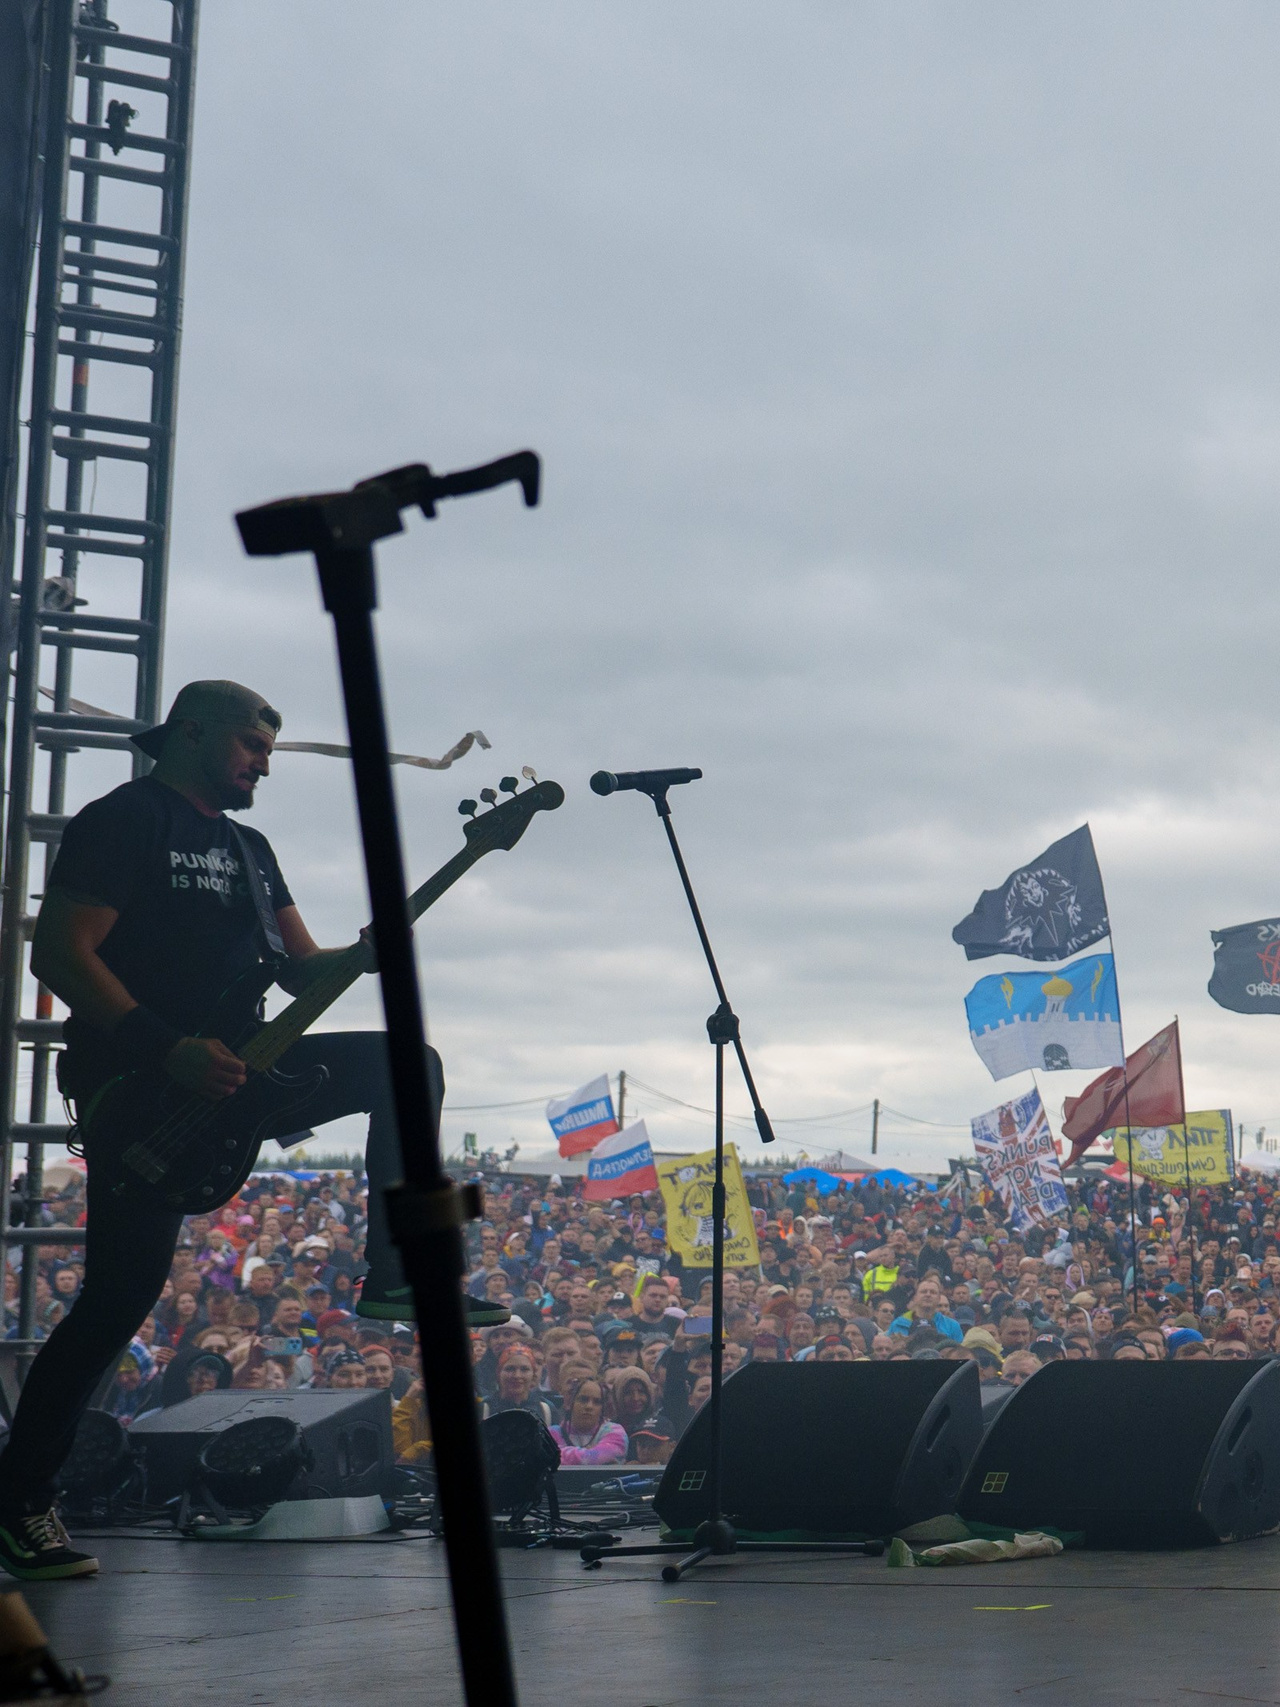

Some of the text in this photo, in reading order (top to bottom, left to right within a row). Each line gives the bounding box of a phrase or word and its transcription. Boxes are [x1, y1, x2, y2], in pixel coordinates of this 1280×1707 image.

[169, 850, 224, 872] PUNK
[171, 874, 190, 889] IS
[196, 875, 225, 893] NOT
